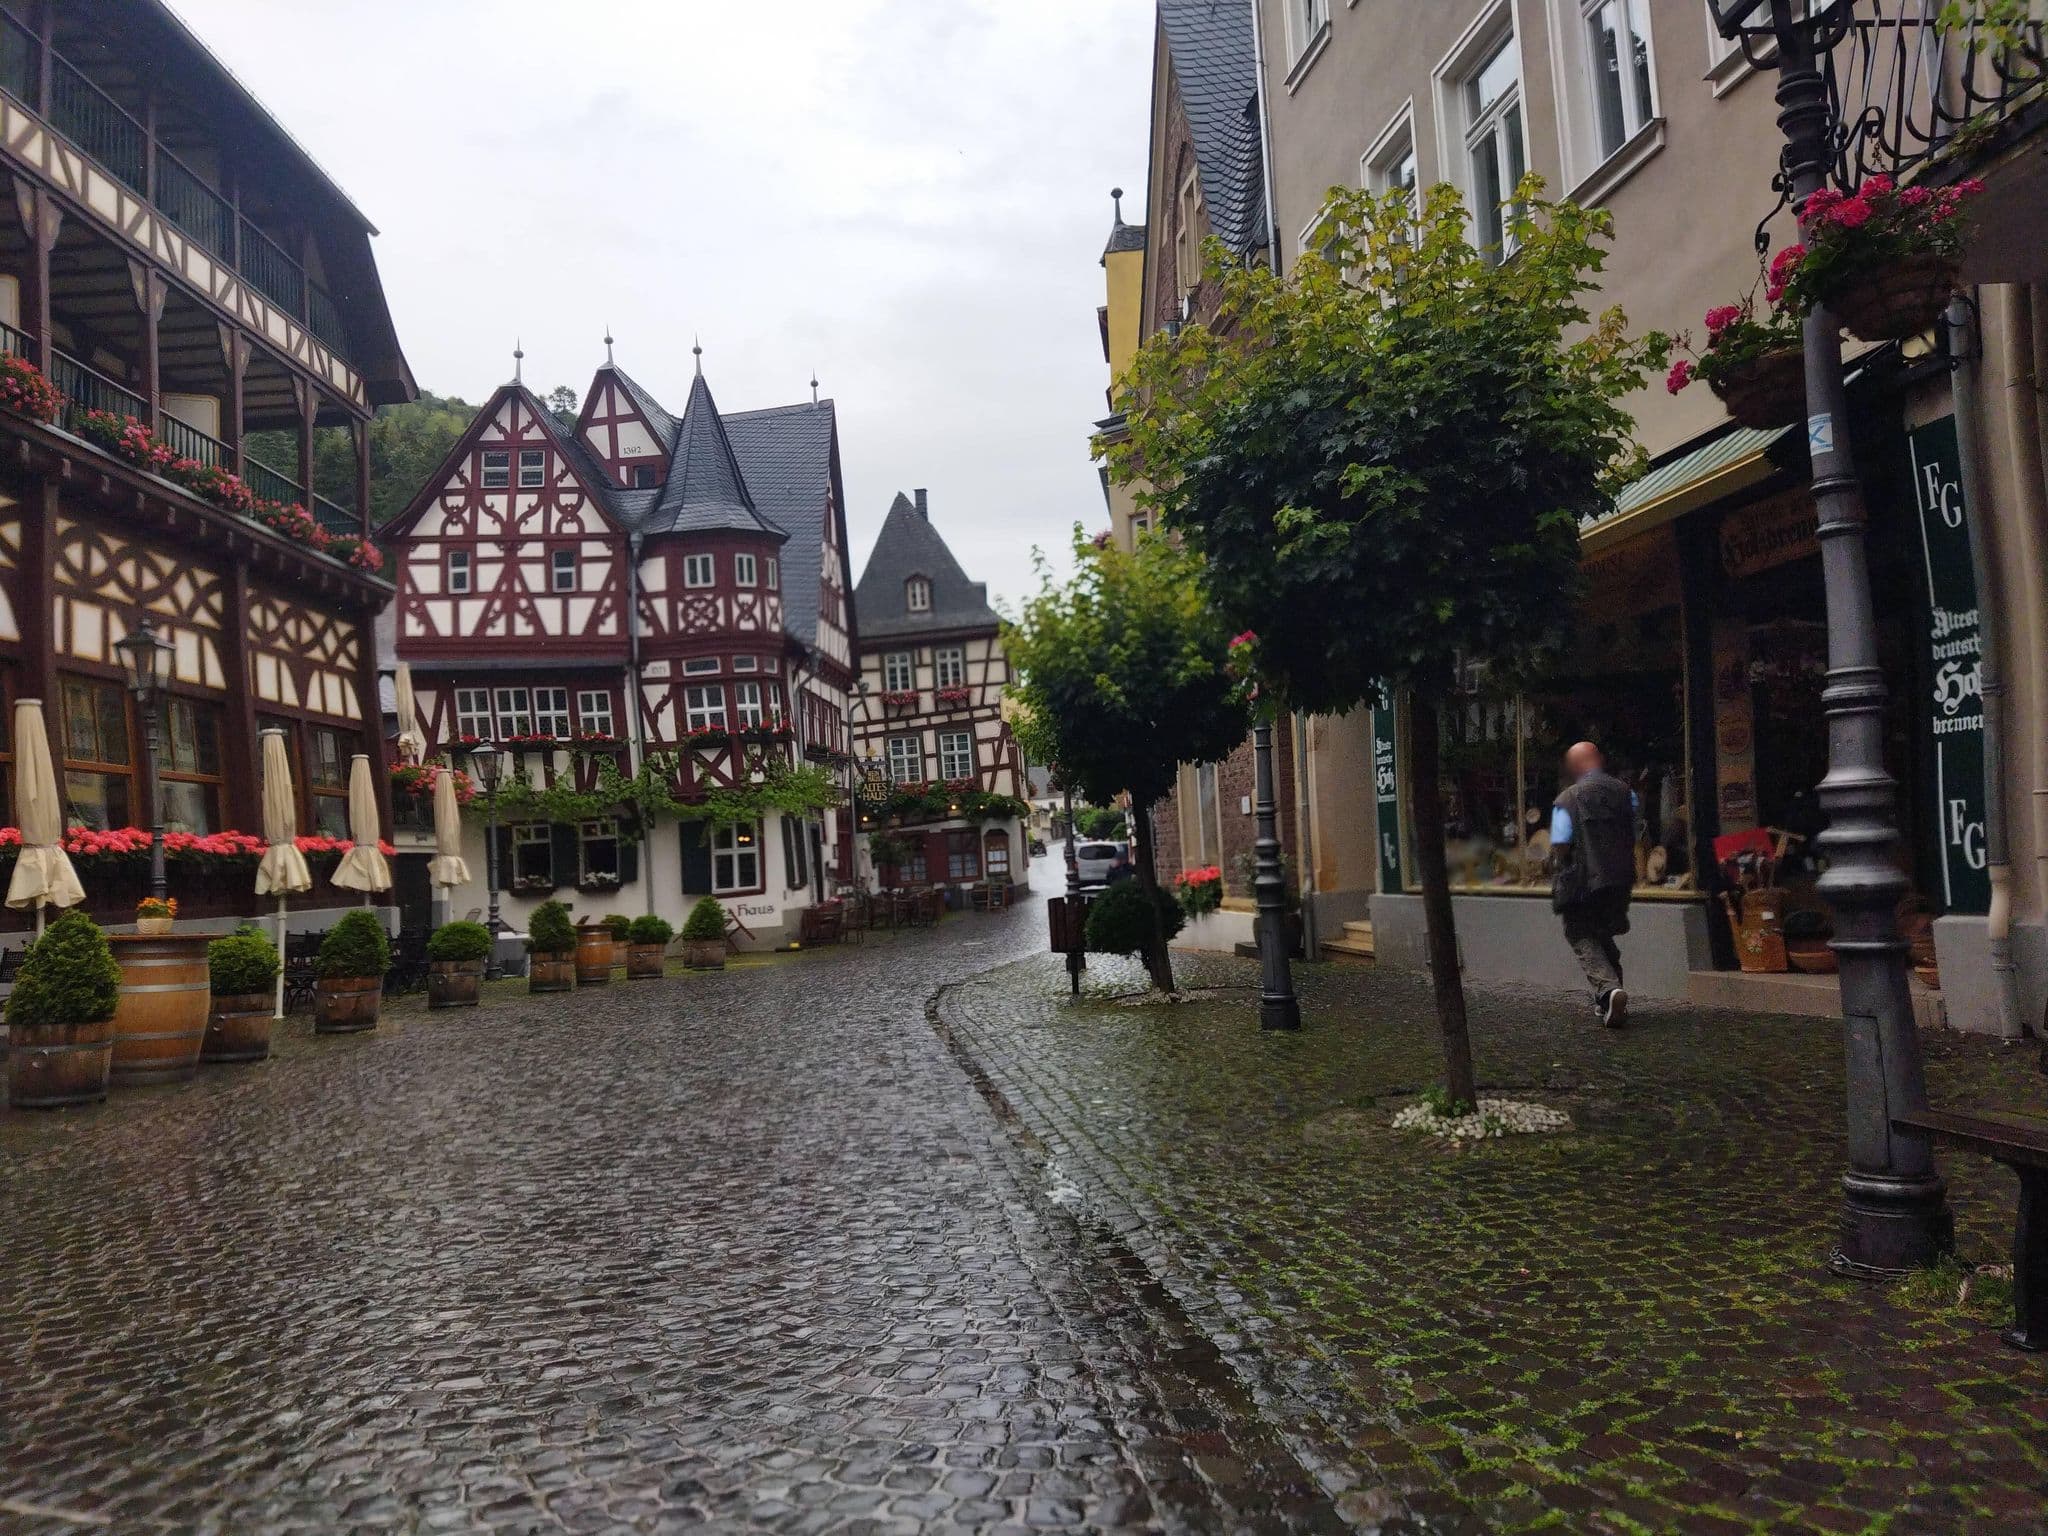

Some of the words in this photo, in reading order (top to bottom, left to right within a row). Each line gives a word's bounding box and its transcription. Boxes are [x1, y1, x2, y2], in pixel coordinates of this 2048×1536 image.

[1923, 461, 1962, 528] FG
[1933, 660, 1984, 716] Hol
[863, 783, 888, 792] ALTES
[863, 792, 888, 801] HAUS
[1949, 799, 1986, 869] FG
[737, 904, 775, 916] Haus
